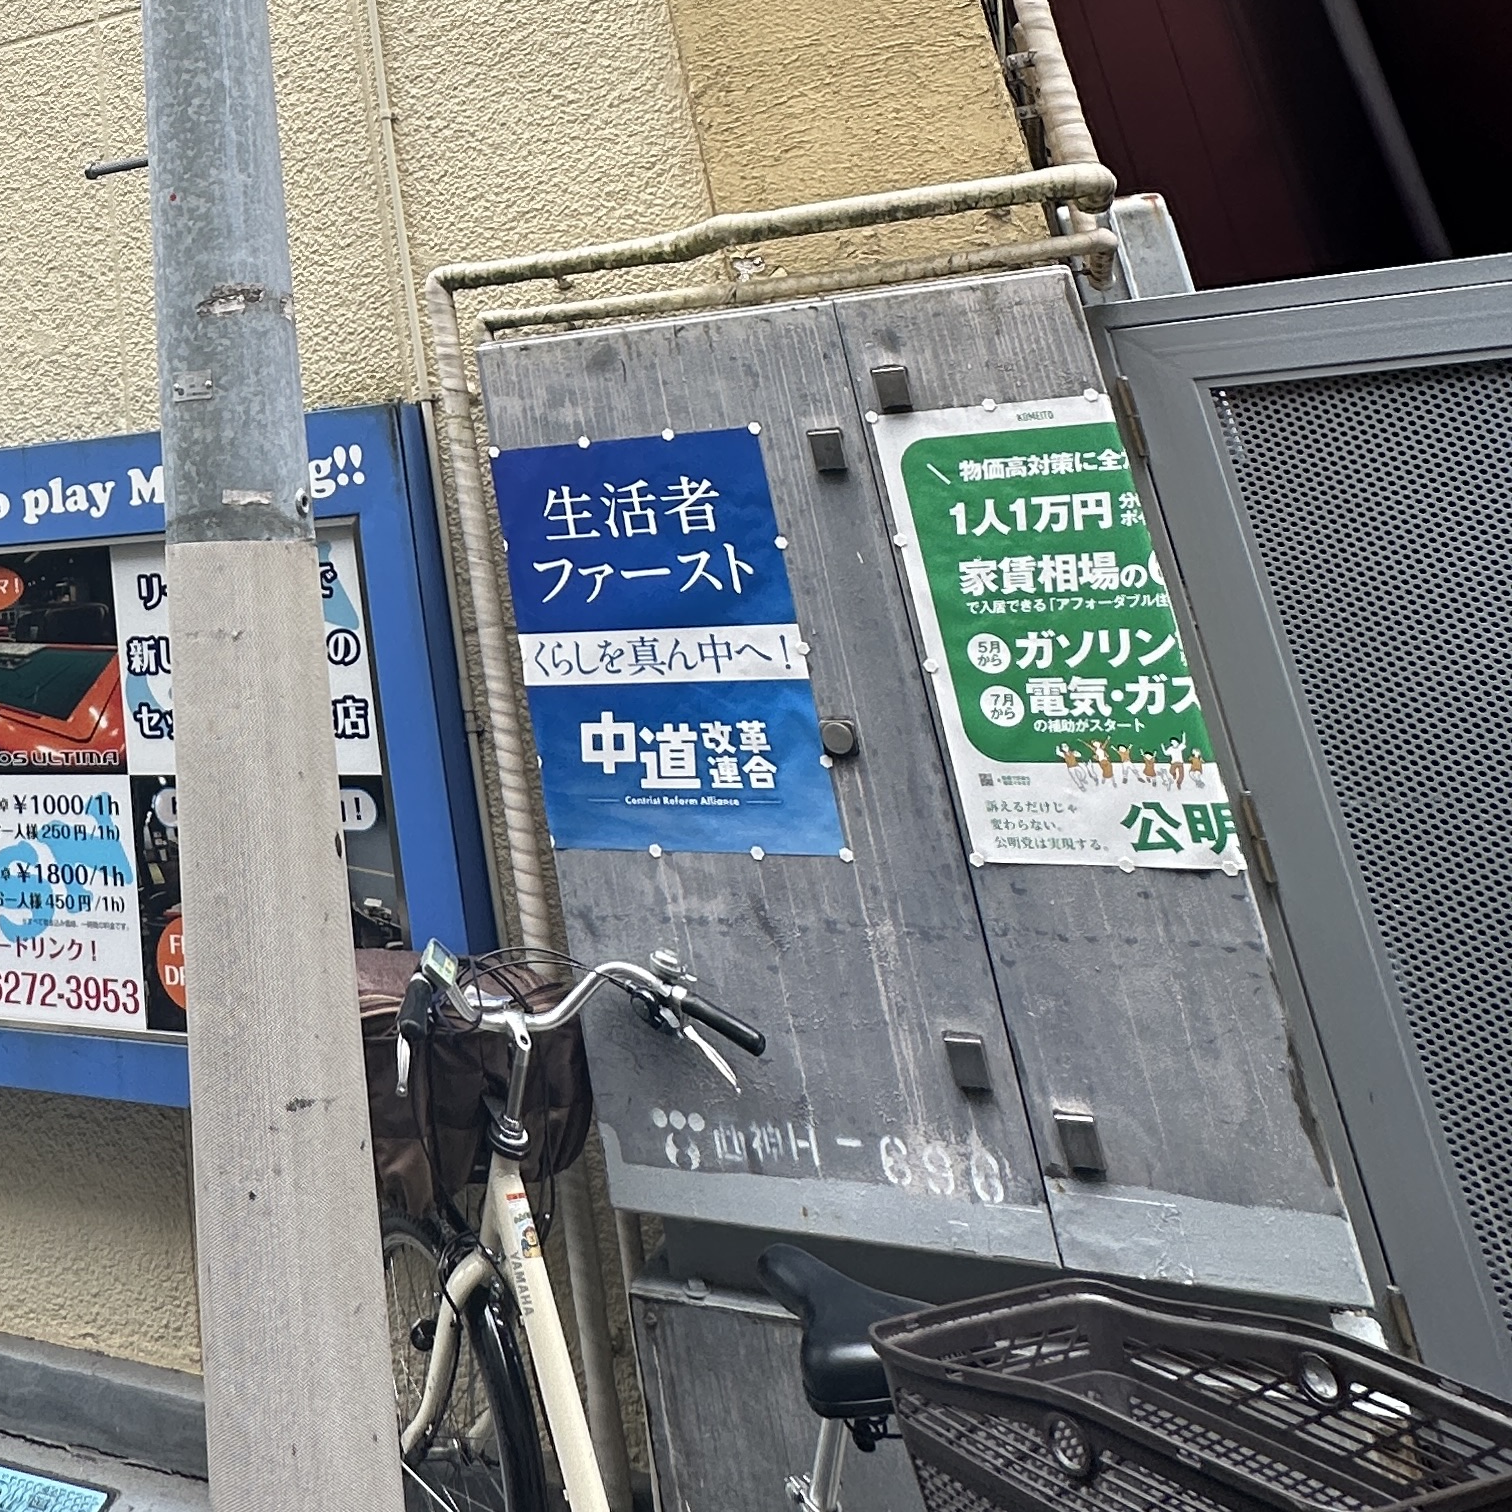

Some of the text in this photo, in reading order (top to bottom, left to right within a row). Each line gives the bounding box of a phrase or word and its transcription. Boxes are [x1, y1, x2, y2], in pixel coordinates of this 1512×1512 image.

[21, 477, 117, 526] play
[542, 475, 720, 542] 生活者
[949, 491, 1113, 537] 1人1万円
[531, 542, 754, 604] ファースト
[533, 633, 793, 678] くらしを真ん中へ!
[978, 641, 1001, 654] 5月
[978, 654, 1003, 667] から
[990, 694, 1014, 707] 7月
[991, 707, 1016, 720] から
[699, 719, 771, 754] 改革
[1034, 717, 1145, 734] の補助がスタート
[31, 749, 119, 767] ULTIMA
[580, 711, 702, 789] 中道
[707, 755, 778, 789] 連合
